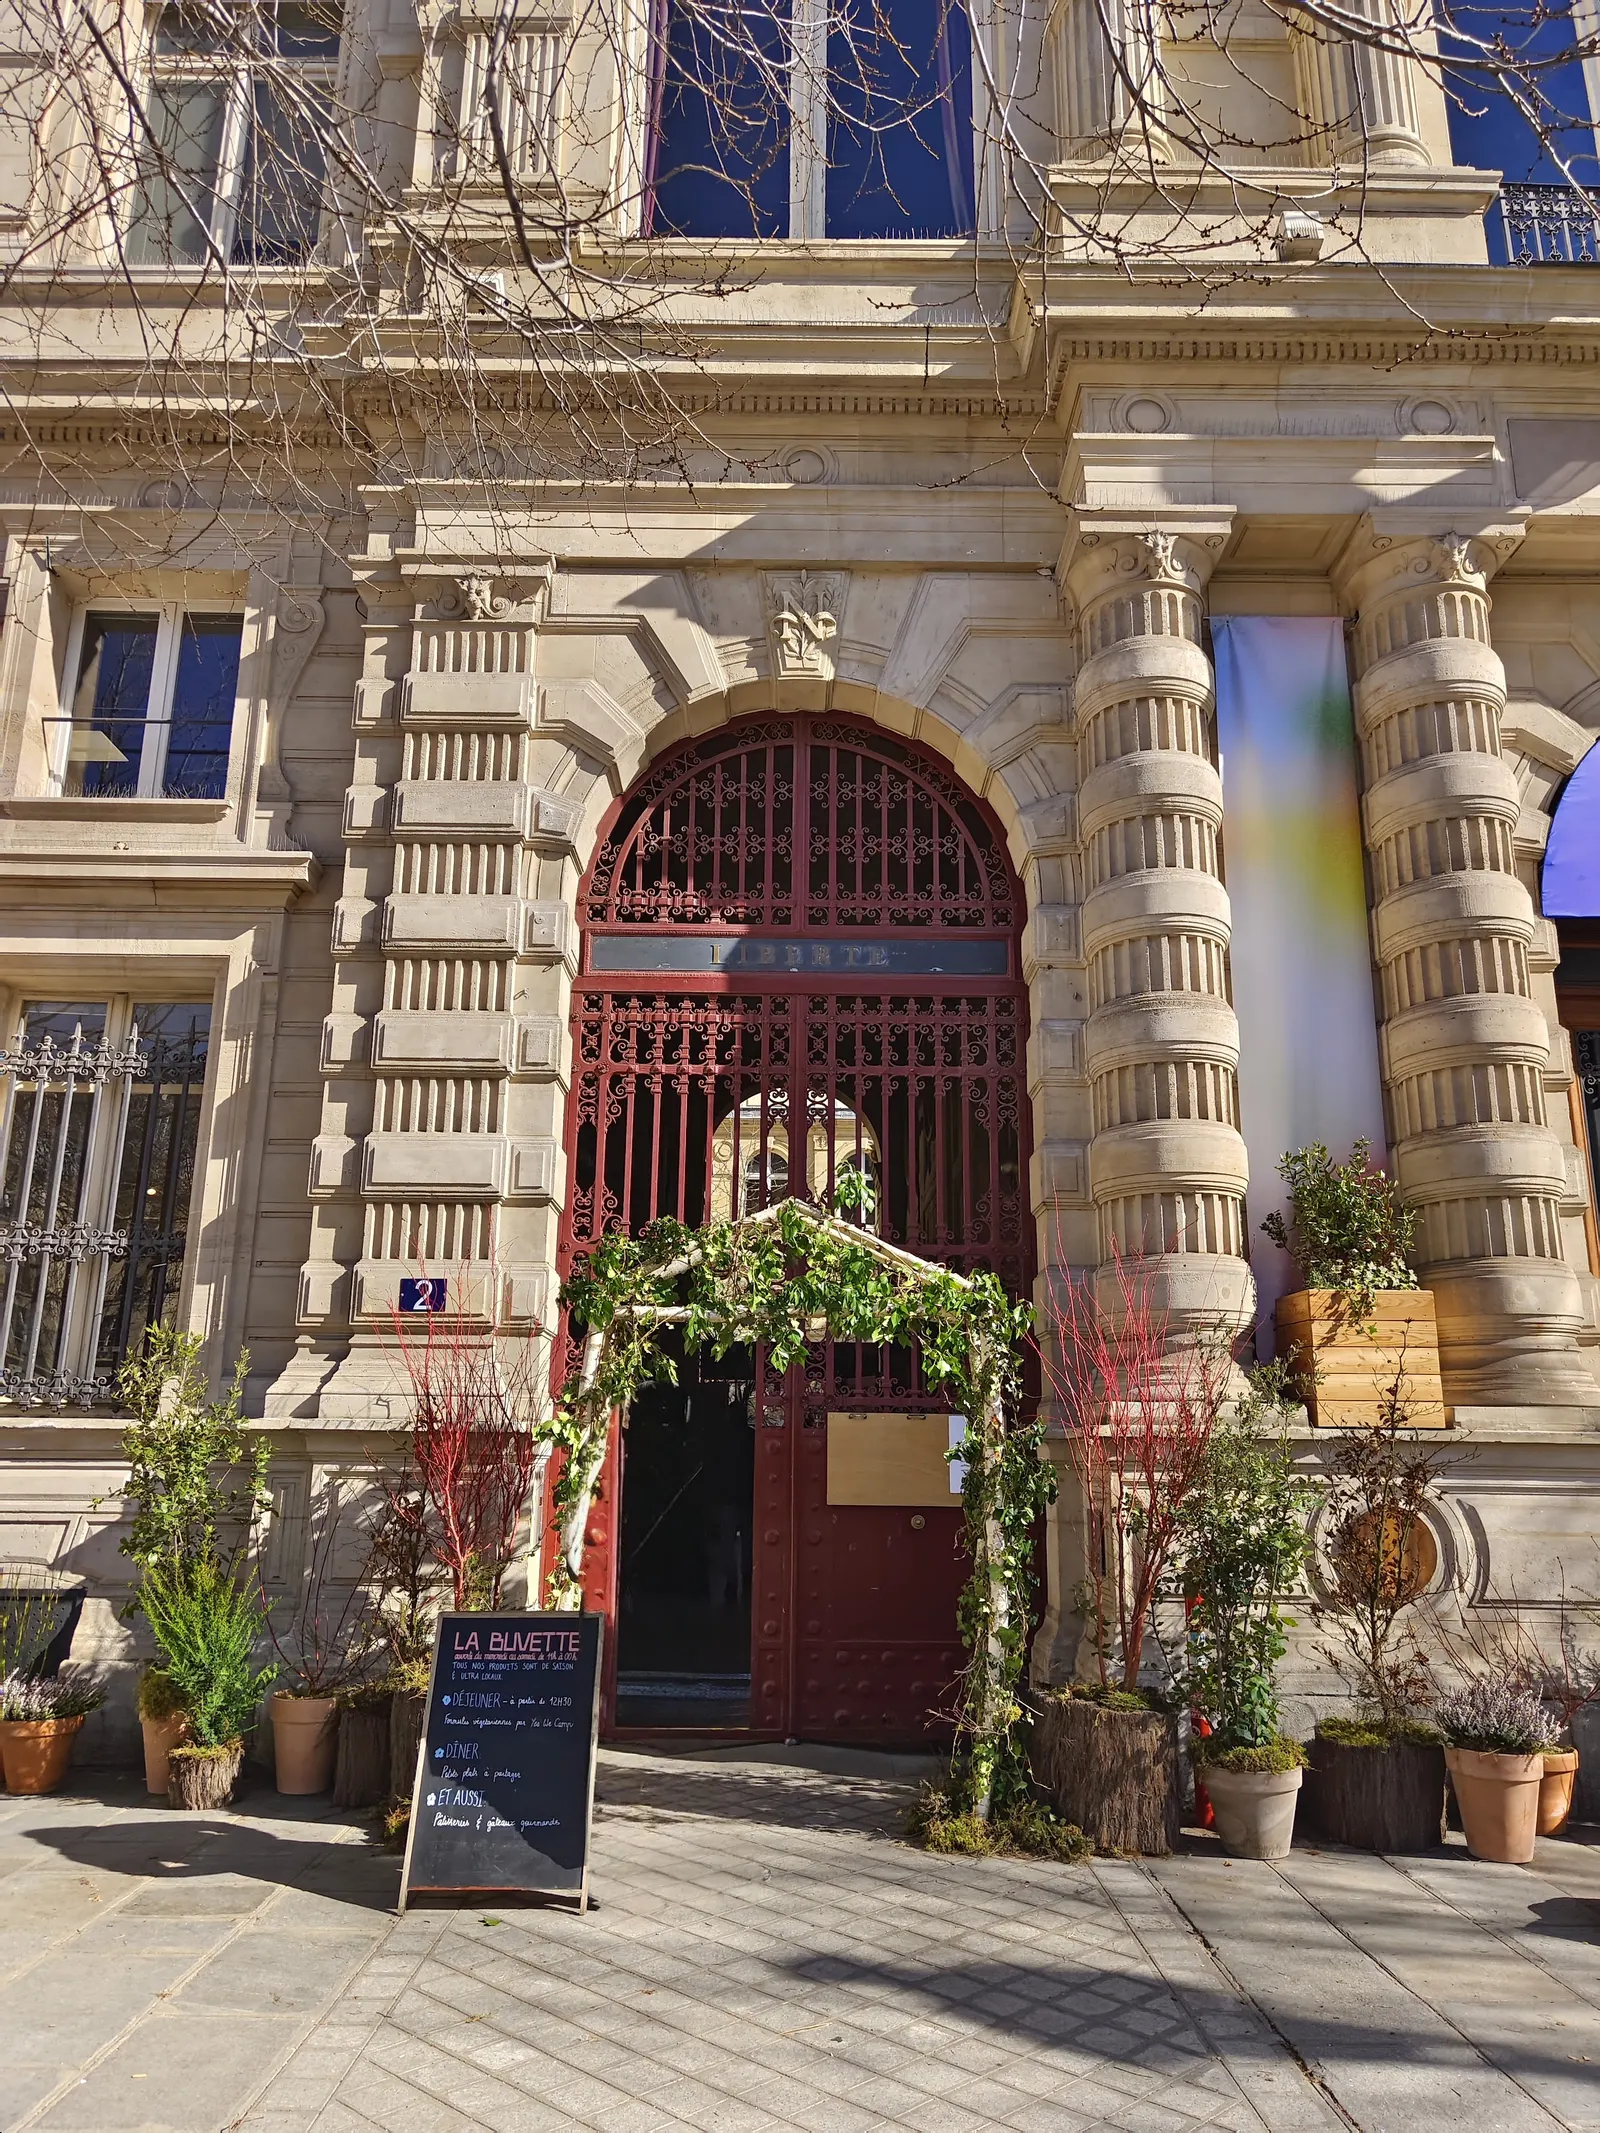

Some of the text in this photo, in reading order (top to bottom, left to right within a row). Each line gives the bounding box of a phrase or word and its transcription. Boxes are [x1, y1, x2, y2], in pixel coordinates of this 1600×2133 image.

[413, 1279, 432, 1310] 2
[454, 1631, 580, 1652] LA BUVETTE
[452, 1661, 468, 1669] TOUS
[472, 1662, 485, 1670] NOS
[489, 1663, 519, 1671] PRODUITS
[460, 1672, 479, 1680] ULTRA
[452, 1689, 501, 1708] DÉJEUNER
[510, 1695, 515, 1705] à
[518, 1695, 536, 1708] partir
[539, 1696, 546, 1705] de
[549, 1696, 572, 1706] 12H30
[515, 1720, 527, 1731] par
[530, 1717, 540, 1728] Yes
[543, 1717, 552, 1728] We
[440, 1765, 521, 1783] Petits plats à partager
[437, 1788, 453, 1806] ET
[433, 1811, 470, 1827] Pâtisseries
[486, 1816, 516, 1833] gâteaux
[519, 1817, 561, 1833] gourmands
